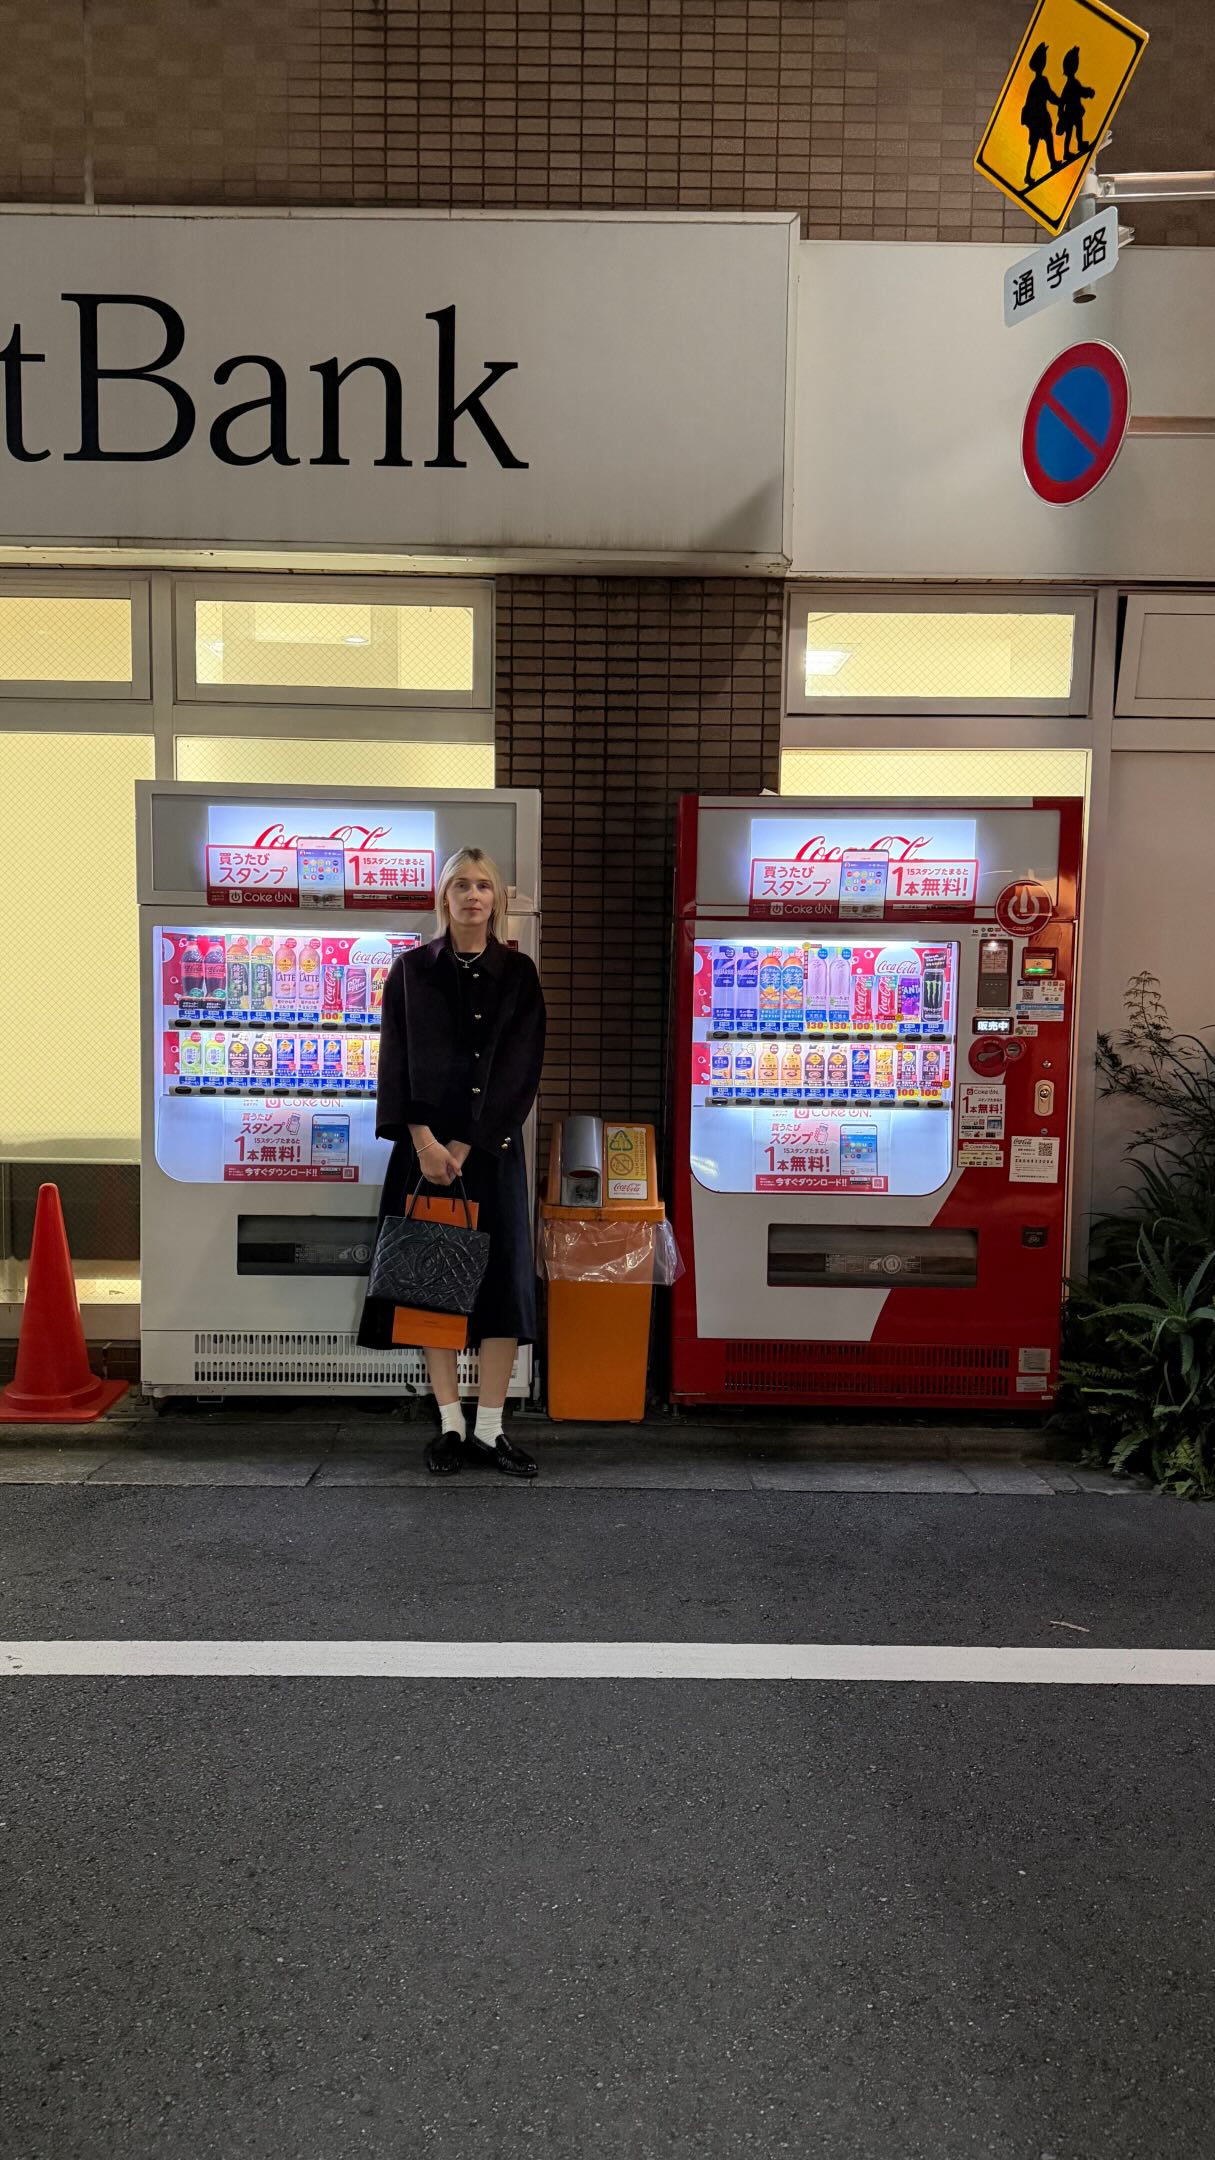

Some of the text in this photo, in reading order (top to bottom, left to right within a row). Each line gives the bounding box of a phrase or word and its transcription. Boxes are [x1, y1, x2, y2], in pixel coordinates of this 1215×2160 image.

[1013, 227, 1107, 310] 通学路
[219, 852, 270, 866] 買うたび
[219, 866, 288, 885] スタンプ
[763, 866, 815, 879] 買うたび
[762, 879, 831, 896] スタンプ
[243, 892, 273, 903] Coke
[784, 905, 812, 915] Coke
[876, 960, 918, 974] Coca-Cola
[977, 1020, 1009, 1031] 販売中
[242, 1112, 272, 1121] 買うたび
[240, 1122, 285, 1135] スタンプ
[771, 1123, 801, 1131] 買うたび
[769, 1133, 814, 1145] スタンプ
